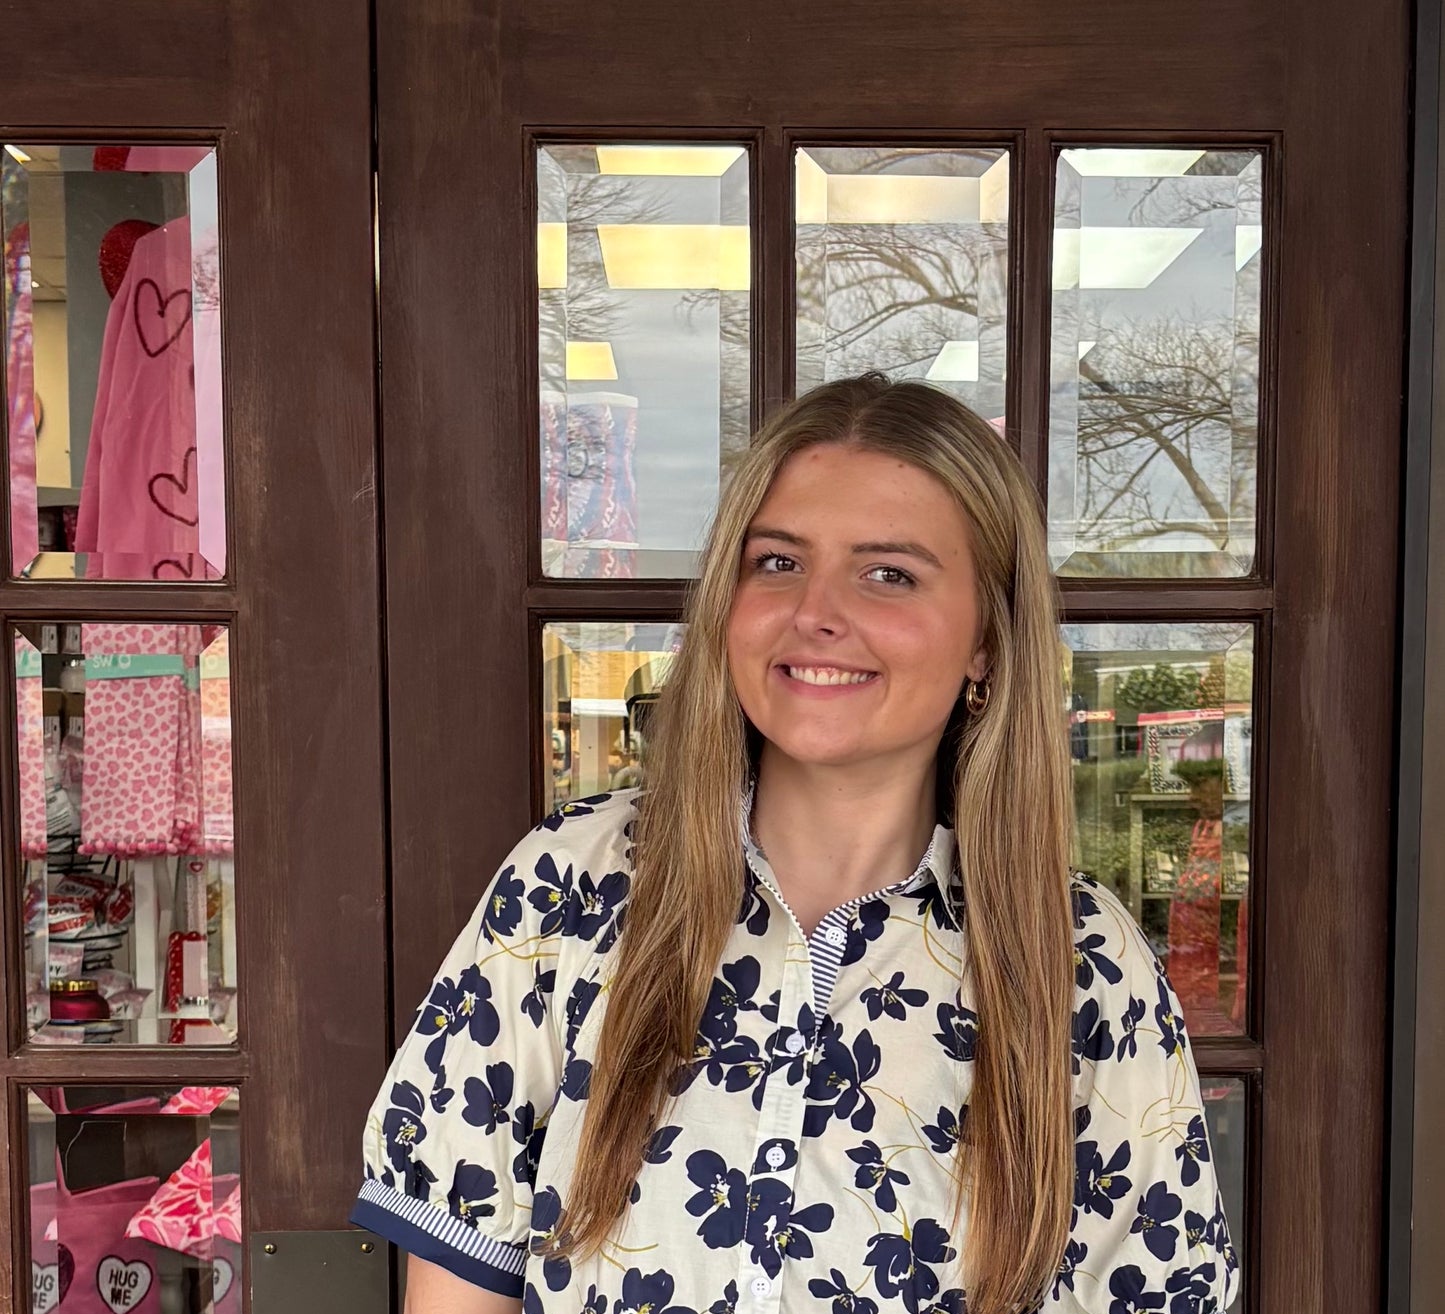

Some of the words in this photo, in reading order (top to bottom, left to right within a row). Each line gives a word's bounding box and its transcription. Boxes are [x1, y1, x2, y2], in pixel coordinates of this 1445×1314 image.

[33, 1274, 54, 1291] UG
[109, 1269, 139, 1289] HUG
[111, 1288, 132, 1306] ME
